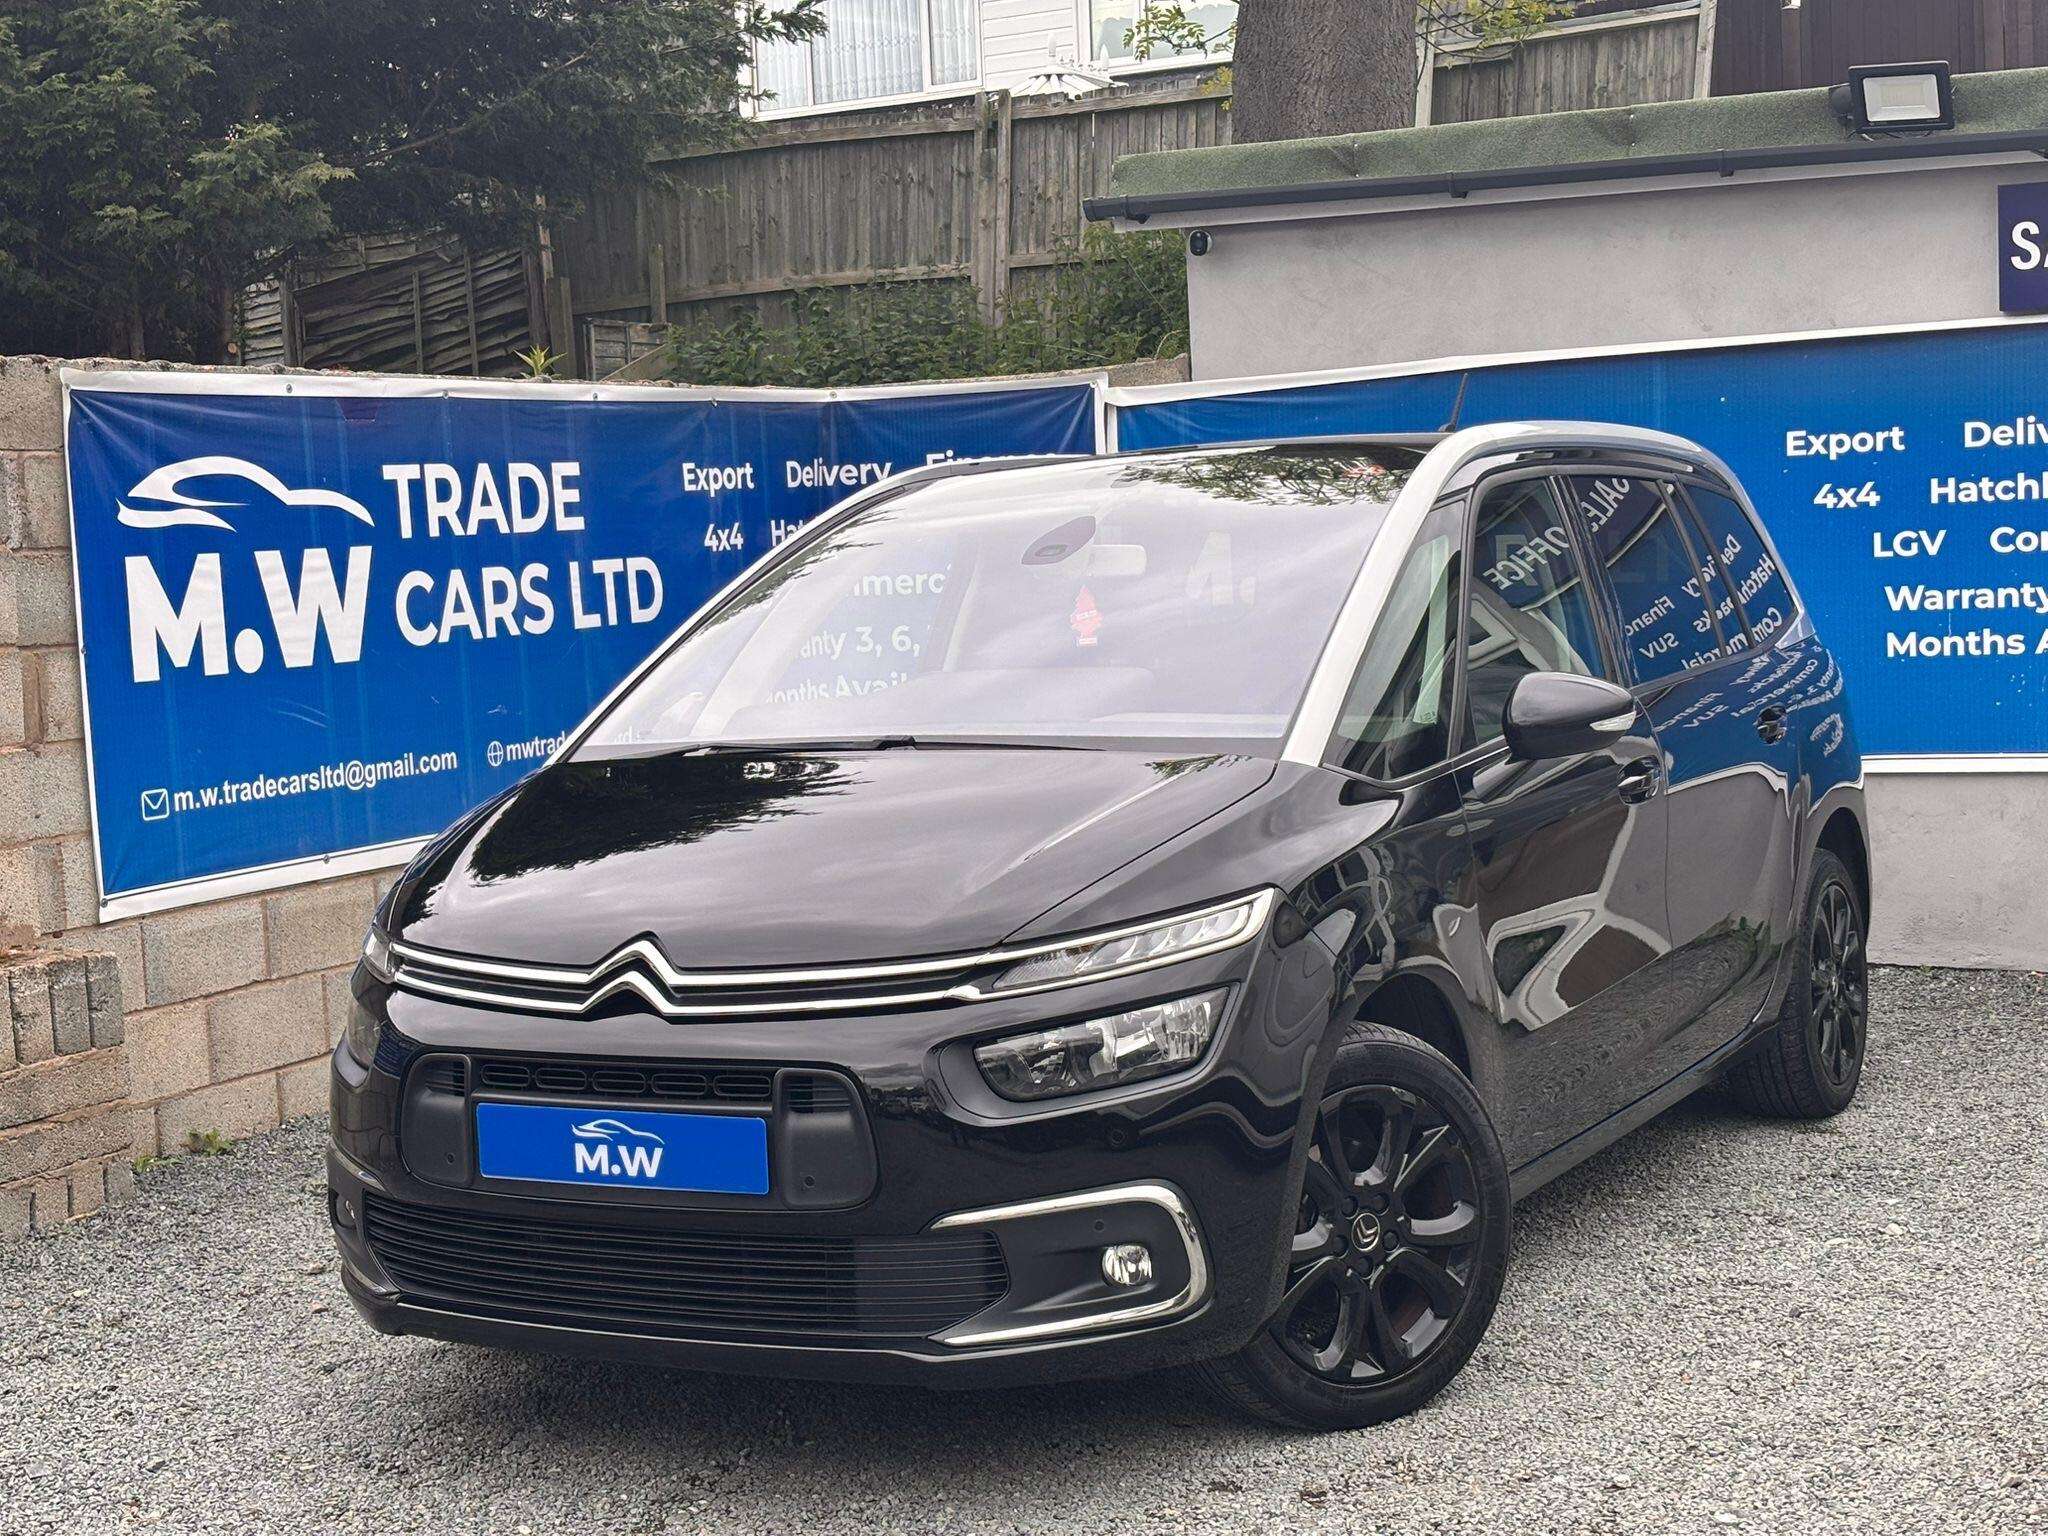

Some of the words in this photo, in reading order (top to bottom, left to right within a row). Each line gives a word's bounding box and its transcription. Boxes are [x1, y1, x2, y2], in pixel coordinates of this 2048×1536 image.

[2010, 221, 2048, 271] S
[1786, 426, 1906, 460] Export
[682, 461, 754, 497] Export
[786, 458, 892, 488] Delivery
[1813, 481, 1881, 509] 4x4
[1930, 471, 2048, 504] Hatch
[382, 461, 586, 539] TRADE
[704, 521, 744, 552] 4x4
[1873, 529, 1947, 558] LGV
[124, 545, 373, 683] M.W
[395, 562, 556, 646] CARS
[569, 556, 664, 630] LTD
[1886, 628, 2025, 657] Months
[173, 751, 458, 812] m.w.tradecarsltd@gmail.com
[574, 1142, 663, 1178] M.W
